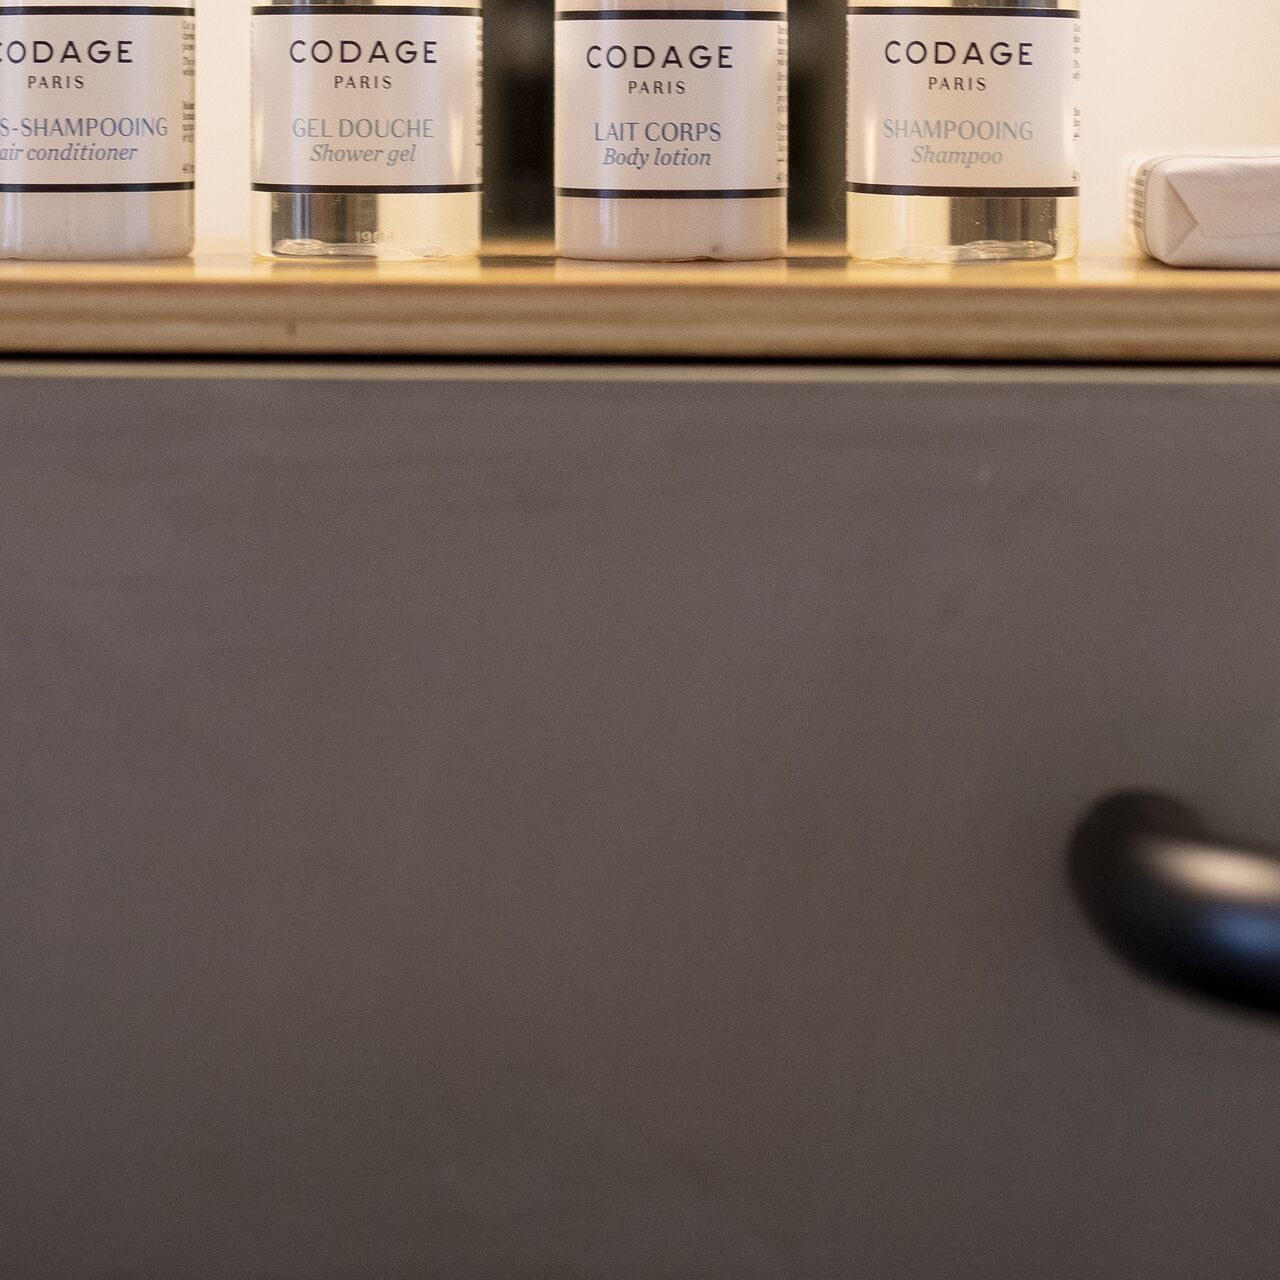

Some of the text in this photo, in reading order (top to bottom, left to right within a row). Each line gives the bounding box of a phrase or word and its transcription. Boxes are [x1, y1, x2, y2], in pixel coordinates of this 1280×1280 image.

[289, 39, 438, 64] CODAGE
[586, 45, 733, 69] CODAGE
[884, 40, 1033, 66] CODAGE
[27, 75, 85, 89] PARIS
[334, 75, 393, 89] PARIS
[628, 80, 686, 95] PARIS
[928, 76, 987, 91] PARIS
[292, 118, 435, 138] GEL DOUCHE
[594, 122, 721, 142] LAIT CORPS
[883, 118, 1034, 141] SHAMPOOING
[26, 143, 138, 161] conditioner
[310, 144, 417, 167] Shower gel
[602, 147, 712, 170] Body lotion
[911, 145, 1003, 168] Shampoo
